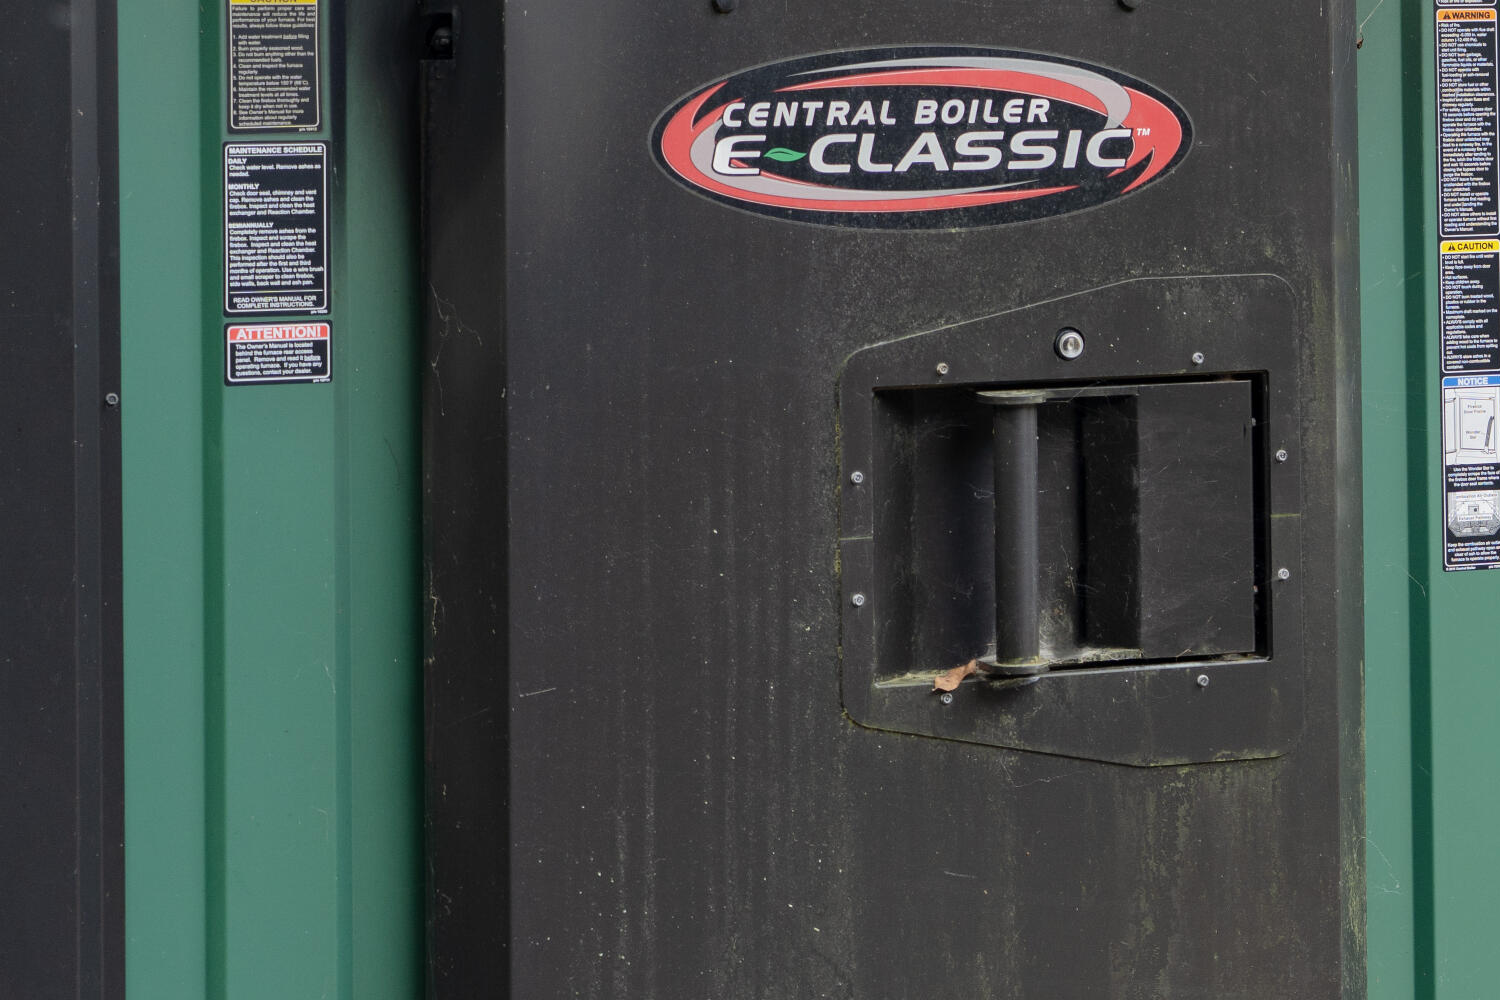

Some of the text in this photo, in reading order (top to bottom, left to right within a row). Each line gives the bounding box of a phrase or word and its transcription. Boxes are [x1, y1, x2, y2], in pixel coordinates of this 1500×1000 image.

[722, 97, 1052, 128] CENTRAL BOILER
[1457, 242, 1493, 250] CAUTION
[236, 326, 321, 340] ATTENTION!
[1458, 377, 1488, 385] NOTICE
